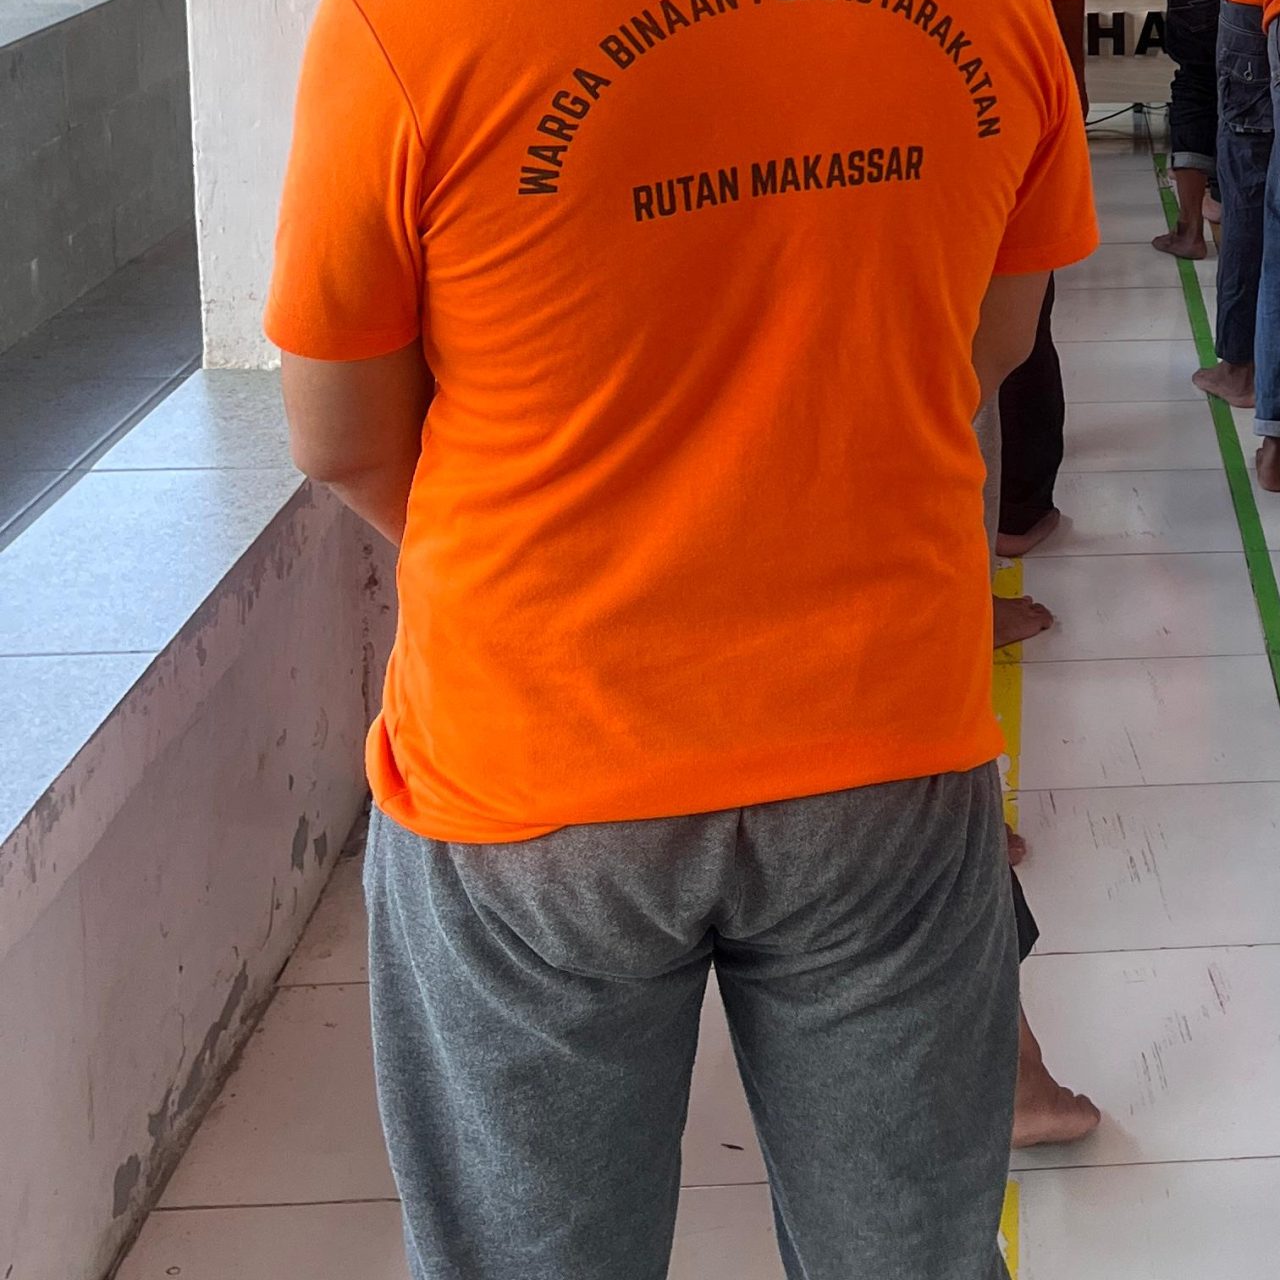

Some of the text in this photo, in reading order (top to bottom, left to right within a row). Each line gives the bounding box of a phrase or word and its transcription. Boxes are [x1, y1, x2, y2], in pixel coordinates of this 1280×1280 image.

[518, 67, 612, 196] WARGA
[631, 145, 925, 223] RUTAN MAKASSAR
